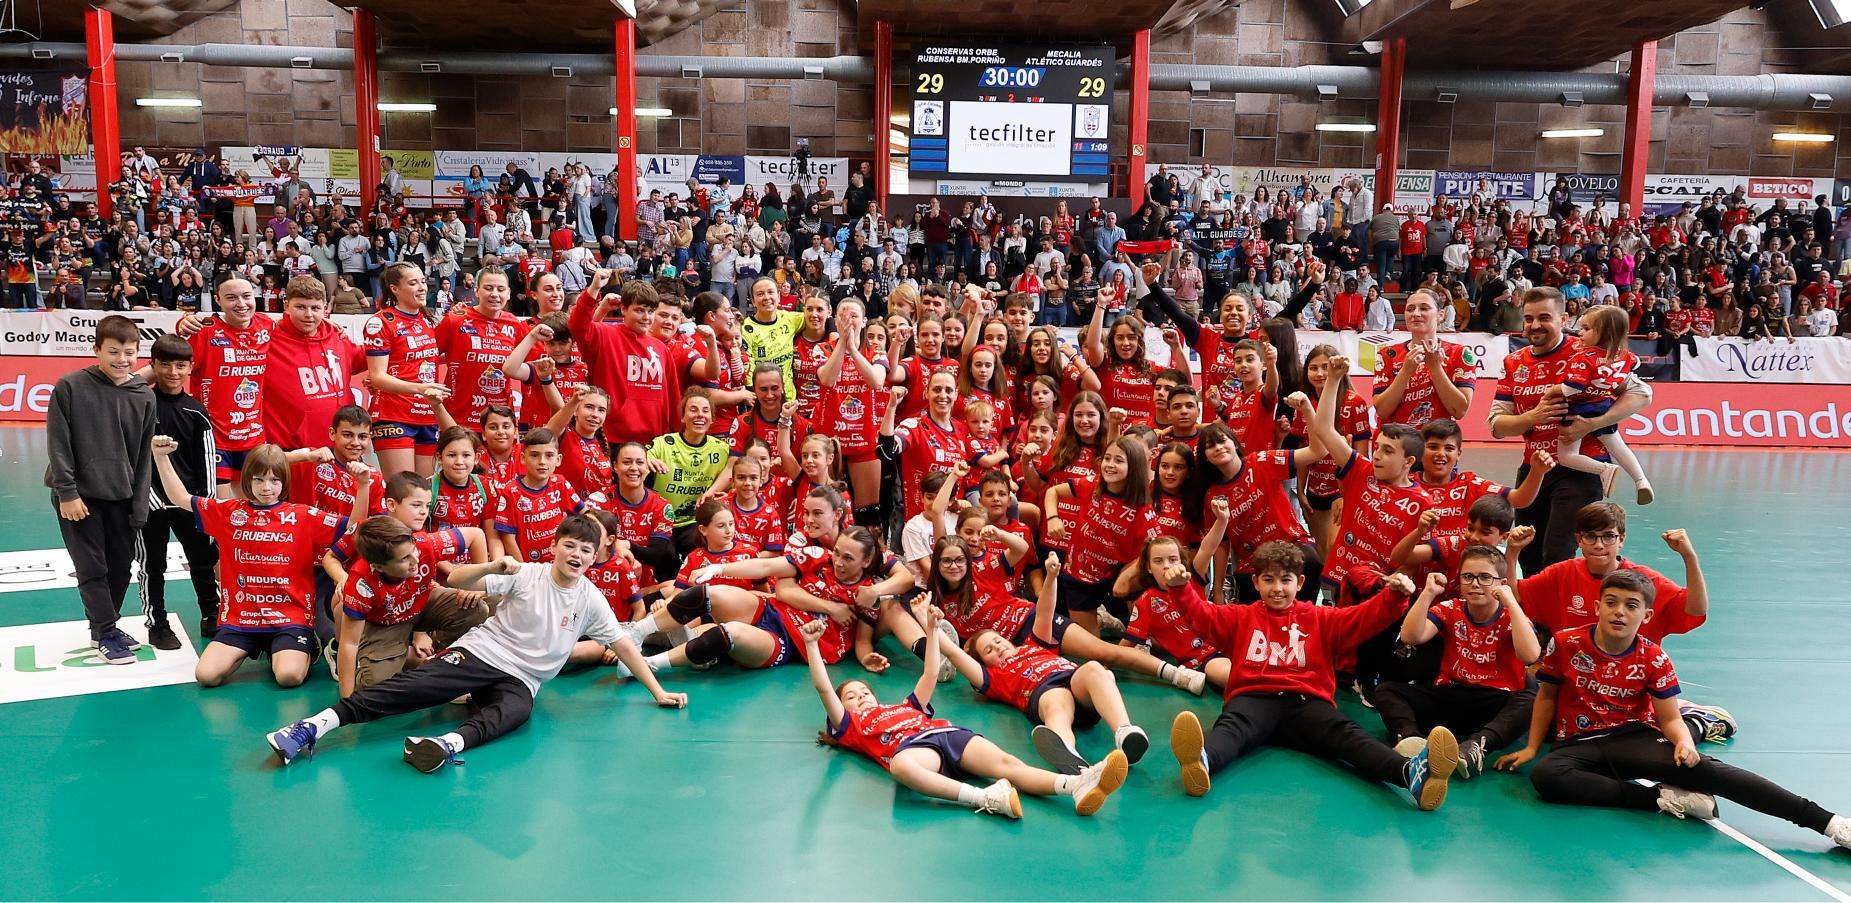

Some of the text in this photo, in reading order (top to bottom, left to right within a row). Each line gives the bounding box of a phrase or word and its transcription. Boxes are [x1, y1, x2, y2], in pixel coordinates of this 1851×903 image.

[926, 47, 998, 57] CONSERVAS ORBE
[1046, 50, 1081, 58] MECALIA
[917, 55, 1006, 65] RUBENSA BM.PORRIÑO
[1025, 57, 1103, 67] ATLÉTICO GUARDÉS
[917, 73, 944, 93] 29
[985, 67, 1040, 87] 30:00
[1077, 77, 1106, 98] 29
[1007, 93, 1015, 103] 2
[970, 123, 1056, 142] tecfilter
[1074, 143, 1083, 151] 11
[1089, 143, 1108, 152] 1:09
[647, 157, 672, 175] AL
[670, 158, 680, 167] 13
[759, 158, 838, 175] tecfter
[1438, 171, 1472, 180] PENSIÓN
[1477, 172, 1532, 181] RESTAURANTE
[1660, 176, 1710, 185] CAFETERÍA
[1752, 182, 1809, 194] BETICO
[527, 264, 546, 278] 27
[500, 324, 515, 338] 40
[780, 323, 790, 335] 12
[4, 331, 50, 344] Godoy
[253, 328, 271, 345] 28
[1716, 342, 1815, 380] Nattex
[478, 377, 505, 388] ORBE
[371, 427, 405, 439] ASTRO
[708, 452, 720, 465] 18
[547, 489, 561, 505] 32
[1449, 484, 1469, 501] 67
[1394, 496, 1421, 516] 40
[277, 510, 298, 526] 14
[1120, 505, 1137, 523] 75
[241, 530, 294, 543] RUBENSA
[246, 575, 290, 585] INDUPOR
[602, 571, 620, 583] 84
[1625, 663, 1646, 680] 23
